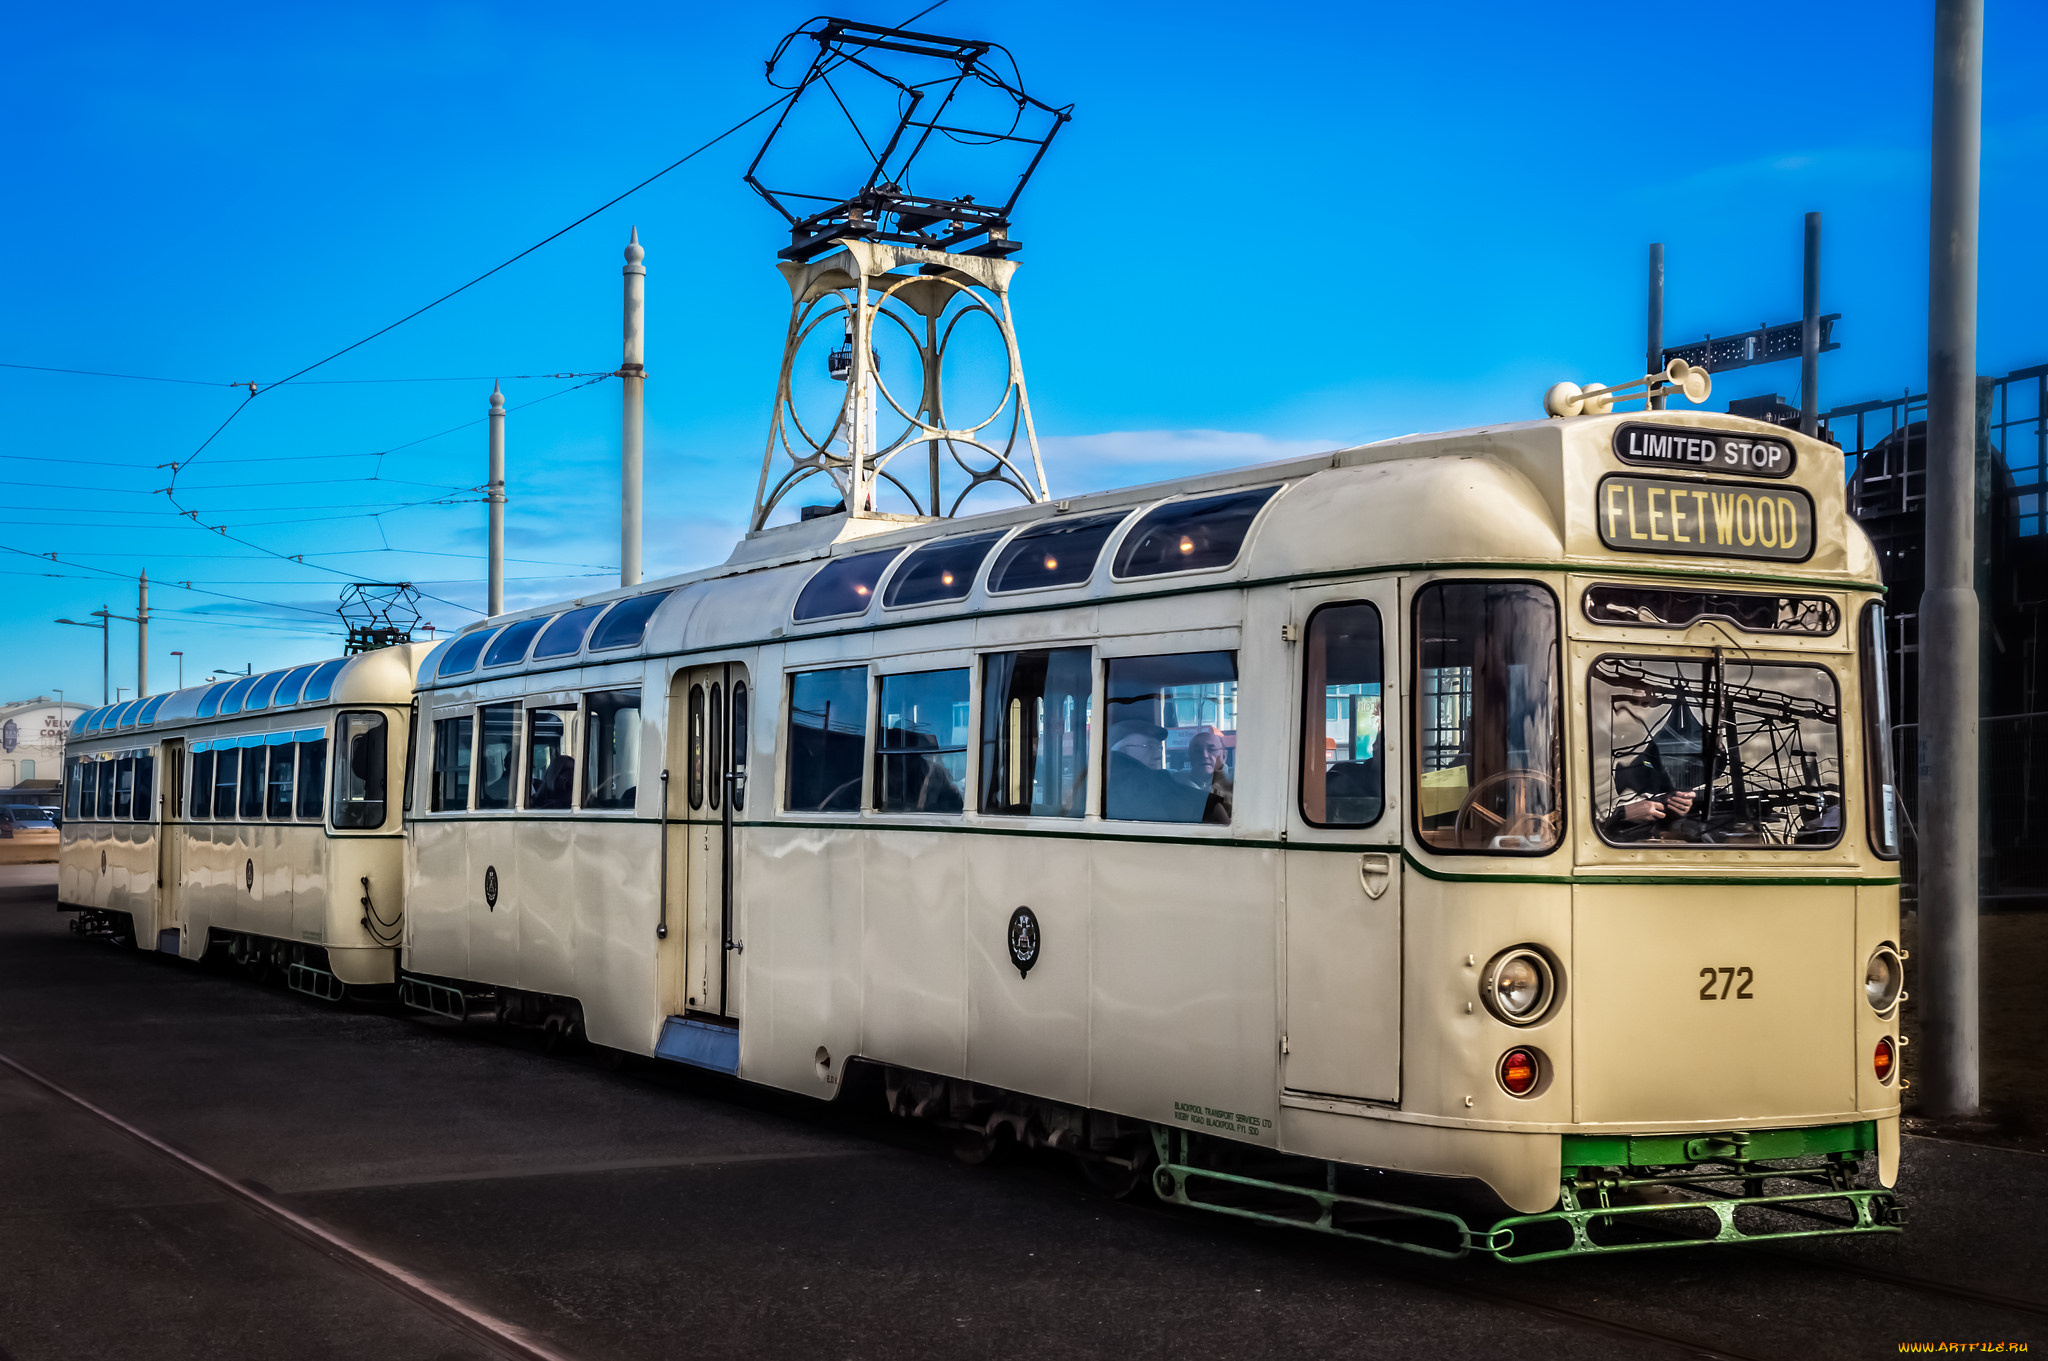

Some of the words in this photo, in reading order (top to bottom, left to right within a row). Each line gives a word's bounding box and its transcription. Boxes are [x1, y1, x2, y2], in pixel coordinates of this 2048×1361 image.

[1629, 432, 1717, 463] LIMITED
[1724, 441, 1782, 468] STOP
[1606, 484, 1798, 550] FLEETWOOD
[1699, 966, 1754, 1001] 272
[1174, 1101, 1203, 1115] BLACKPOOL
[1204, 1107, 1234, 1120] TRANSPORT
[1235, 1113, 1260, 1126] SERVICES
[1261, 1118, 1273, 1129] LTD
[1190, 1115, 1205, 1125] ROAD
[1206, 1118, 1236, 1132] BLACKPOOL
